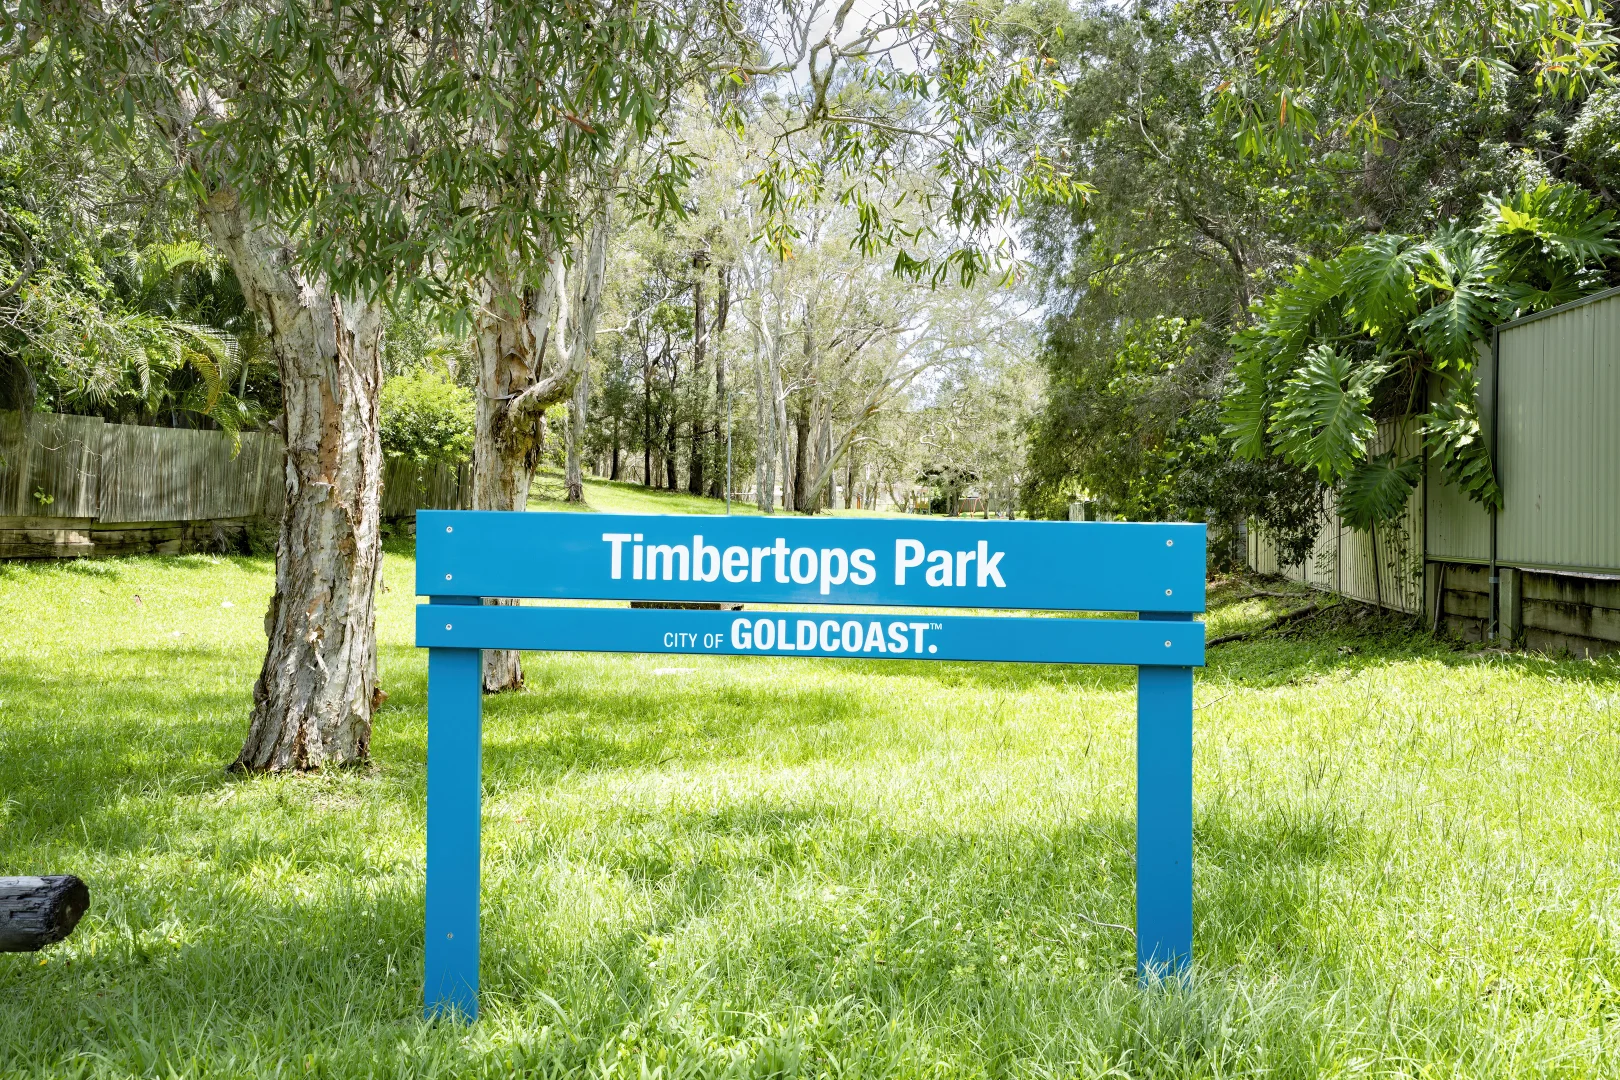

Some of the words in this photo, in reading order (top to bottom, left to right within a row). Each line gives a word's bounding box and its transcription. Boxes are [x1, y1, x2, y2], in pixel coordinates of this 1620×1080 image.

[602, 533, 877, 596] Timbertops
[895, 538, 1007, 588] Park
[663, 632, 698, 648] CITY
[703, 633, 724, 649] OF
